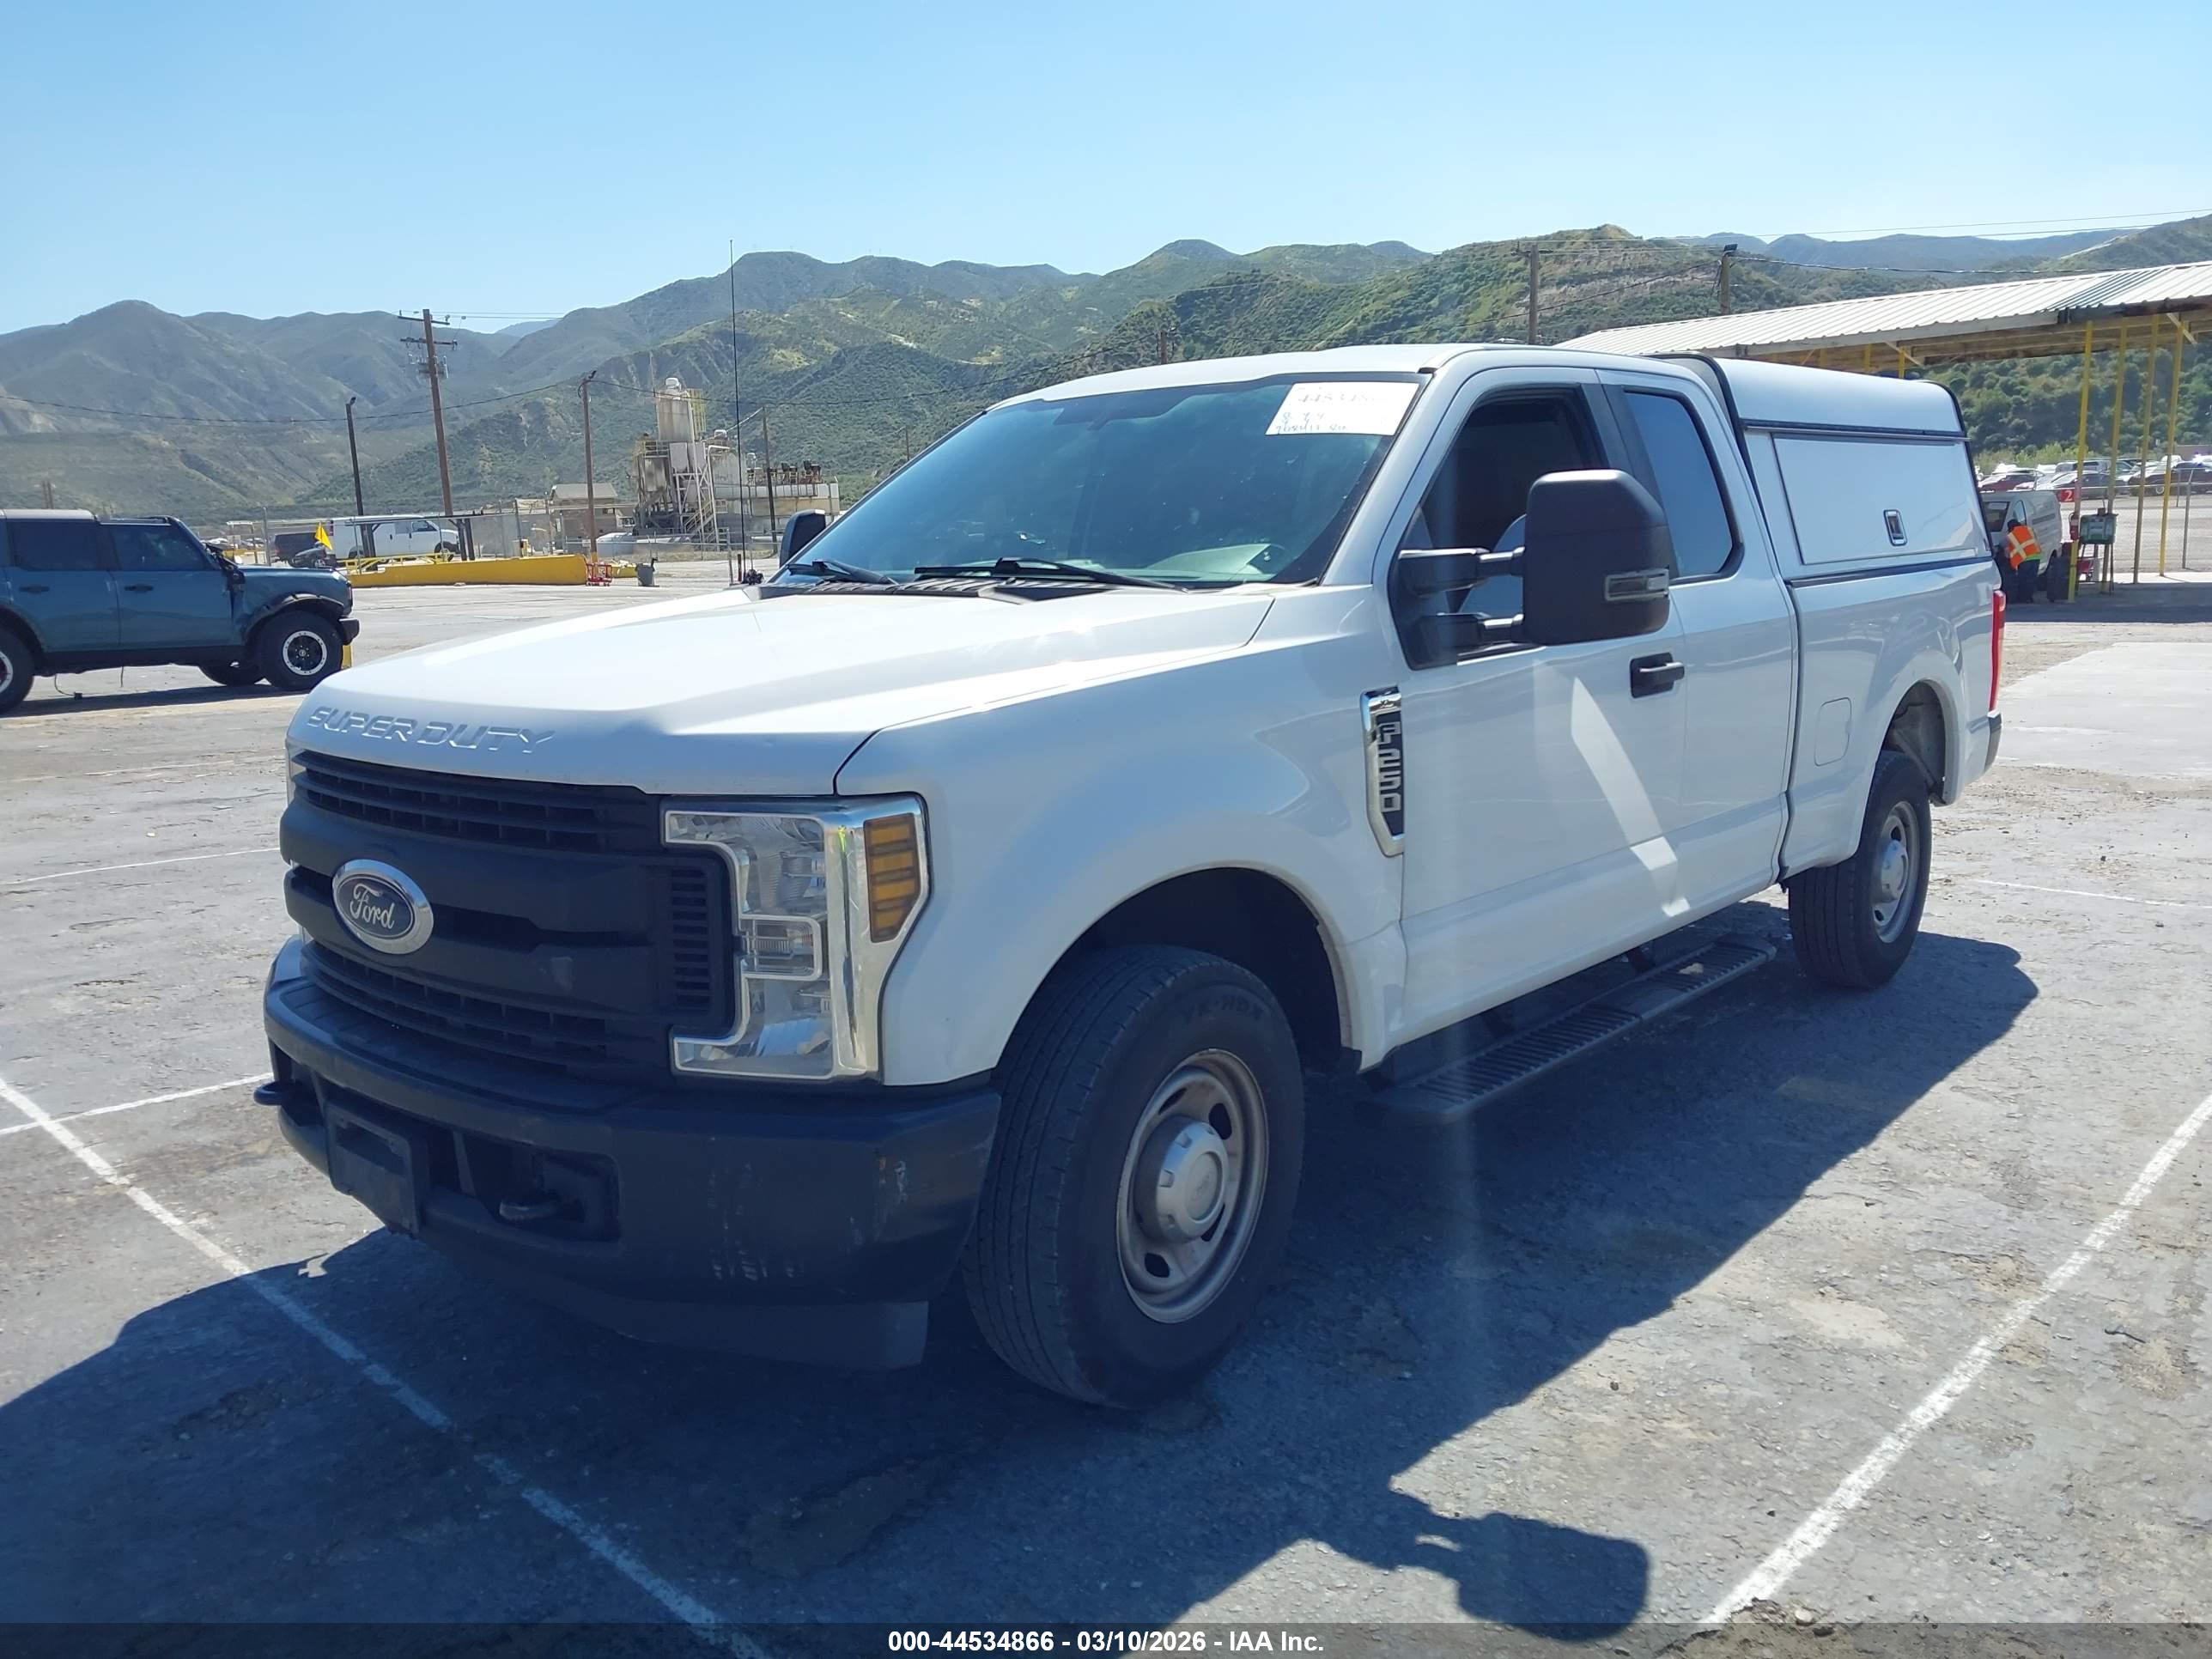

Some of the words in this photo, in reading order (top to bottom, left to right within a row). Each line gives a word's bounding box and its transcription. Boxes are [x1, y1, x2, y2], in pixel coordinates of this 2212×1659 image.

[307, 705, 417, 743] SUPER
[416, 720, 556, 754] DUTY
[349, 882, 395, 930] Ford
